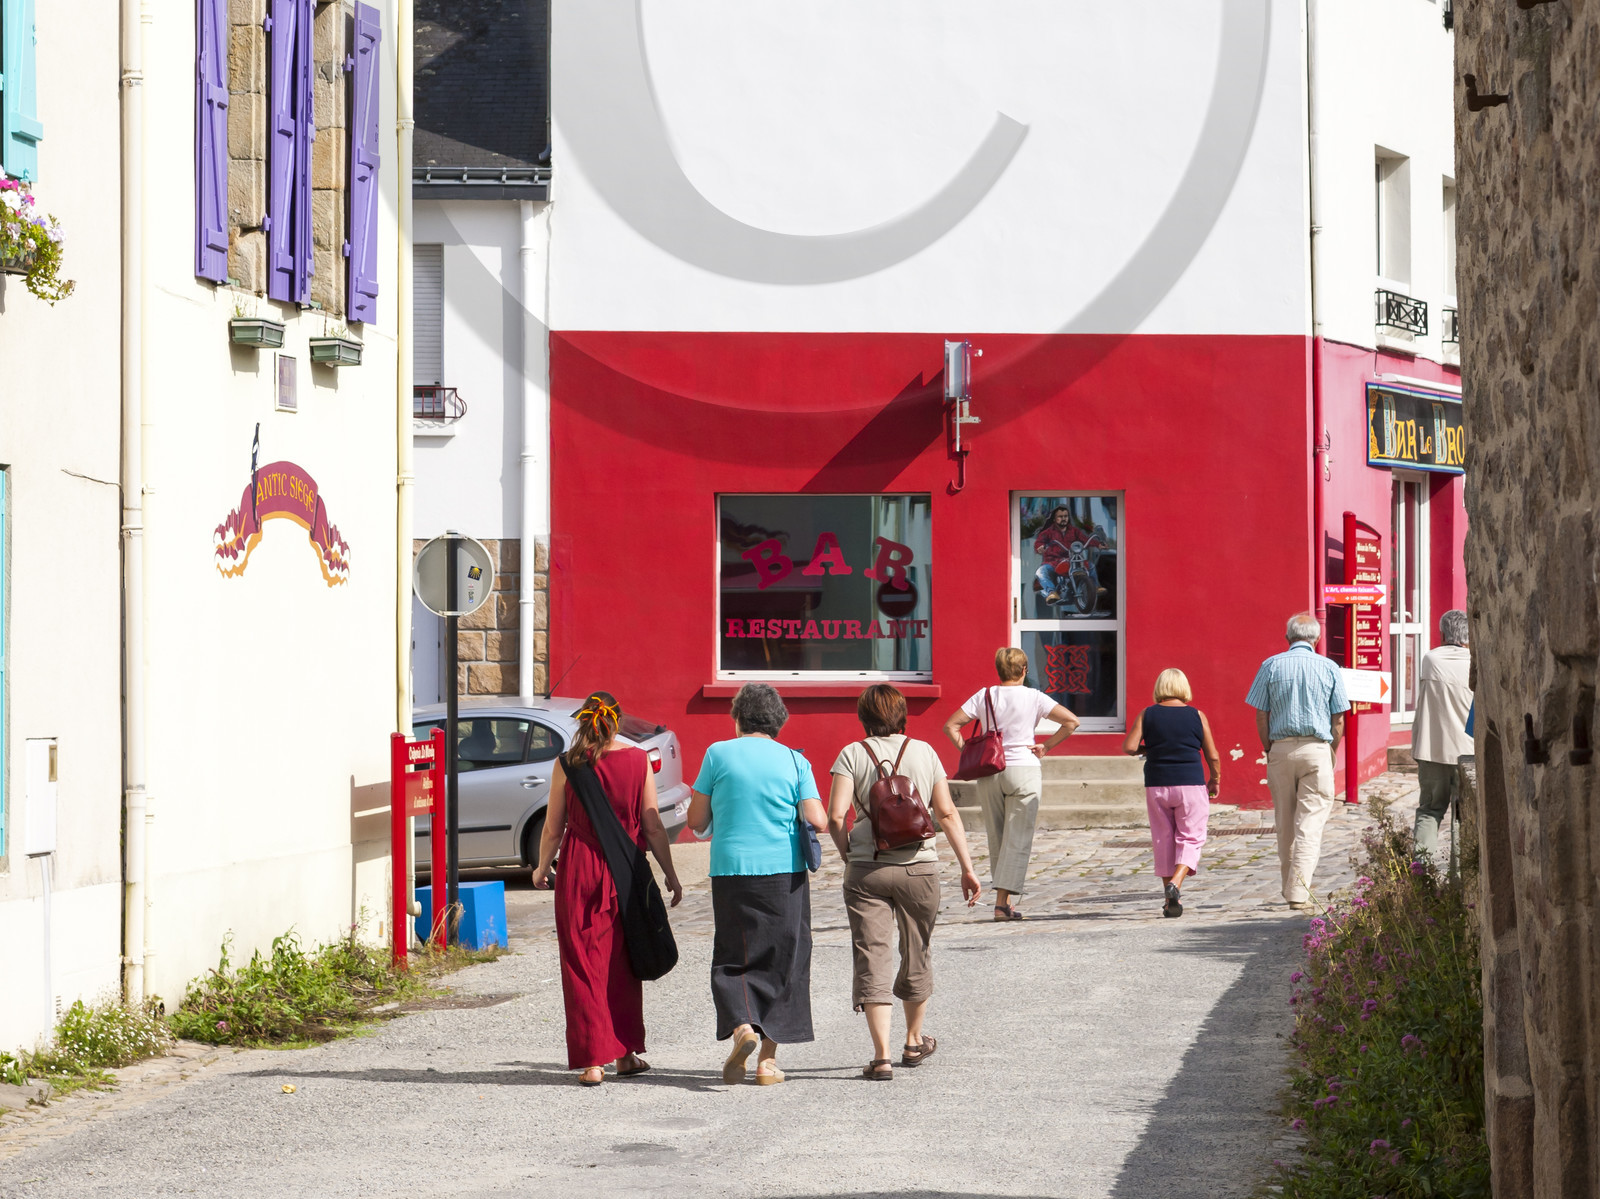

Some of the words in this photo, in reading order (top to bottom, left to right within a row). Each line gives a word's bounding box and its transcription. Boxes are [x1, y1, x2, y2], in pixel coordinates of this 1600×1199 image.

[256, 472, 287, 506] ANTIC
[289, 475, 315, 513] SIEGE
[741, 531, 914, 591] BAR
[725, 618, 928, 639] RESTAURANT
